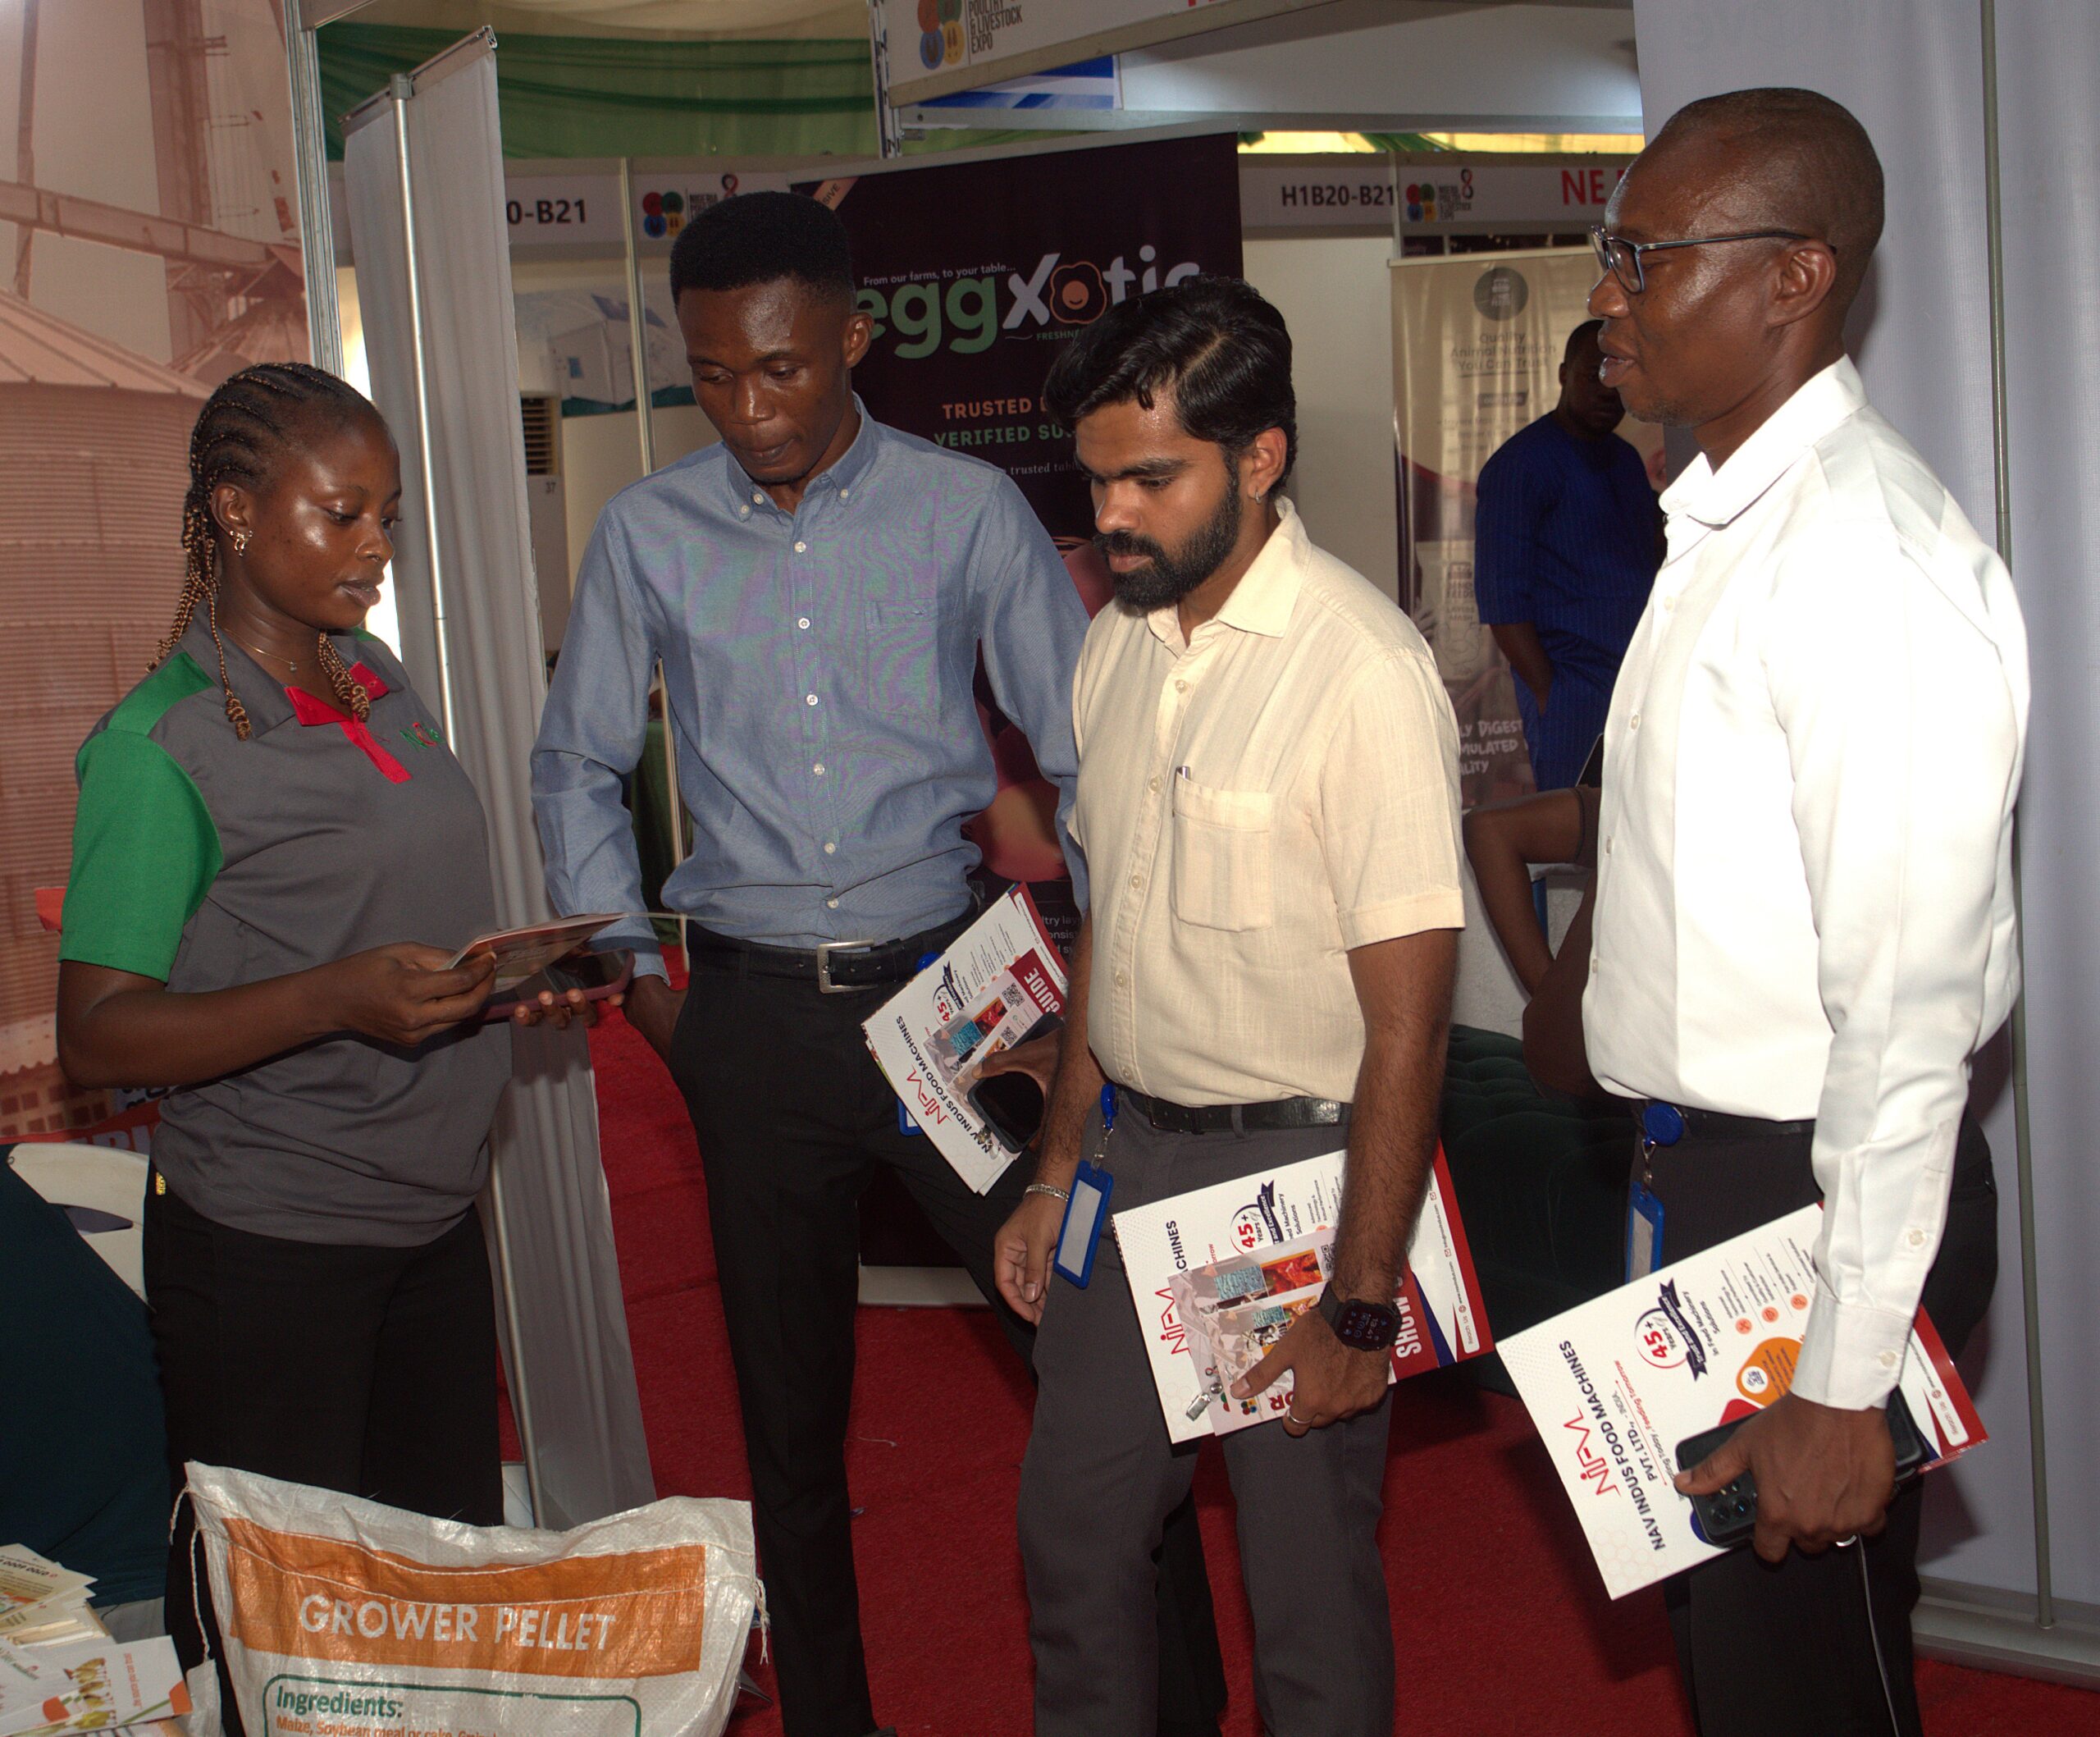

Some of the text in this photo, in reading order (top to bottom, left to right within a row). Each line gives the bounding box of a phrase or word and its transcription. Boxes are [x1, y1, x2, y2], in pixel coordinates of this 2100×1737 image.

[977, 5, 1023, 33] LIVESTOCK
[970, 32, 993, 53] EXPO
[1281, 184, 1395, 207] H1B20-B21
[864, 276, 888, 286] From
[890, 273, 907, 283] our
[943, 267, 952, 277] to
[953, 265, 978, 279] your
[1479, 331, 1525, 345] Quality
[943, 397, 1032, 420] TRUSTED
[934, 425, 1030, 448] VERIFIED
[1010, 463, 1050, 476] trusted
[1021, 966, 1062, 1017] GUIDE
[897, 1016, 928, 1072] MACHINES
[926, 1072, 948, 1101] FOOD
[946, 1100, 972, 1131] INDUS
[1259, 1194, 1278, 1240] and Excellence
[1279, 1194, 1290, 1227] Machinery
[1291, 1204, 1302, 1235] Solutions
[1164, 1218, 1189, 1273] CHINES
[1255, 1223, 1263, 1242] Years
[1463, 1315, 1468, 1323] Us
[1682, 1291, 1704, 1328] Machinery
[1701, 1301, 1720, 1334] Solutions
[1465, 1325, 1473, 1345] Reach
[1663, 1328, 1677, 1350] Years
[1701, 1328, 1714, 1347] Feed
[1614, 1360, 1636, 1398] Tomorrow
[1634, 1398, 1651, 1430] Feeding
[1559, 1341, 1668, 1552] NAV INDUS FOOD MACHINES
[1639, 1452, 1658, 1481] PVT.
[299, 1594, 616, 1651] GROWER PELLET
[276, 1685, 403, 1718] Ingredients:
[276, 1716, 313, 1736] Maize,
[317, 1717, 370, 1737] Soybean
[374, 1725, 404, 1737] meal
